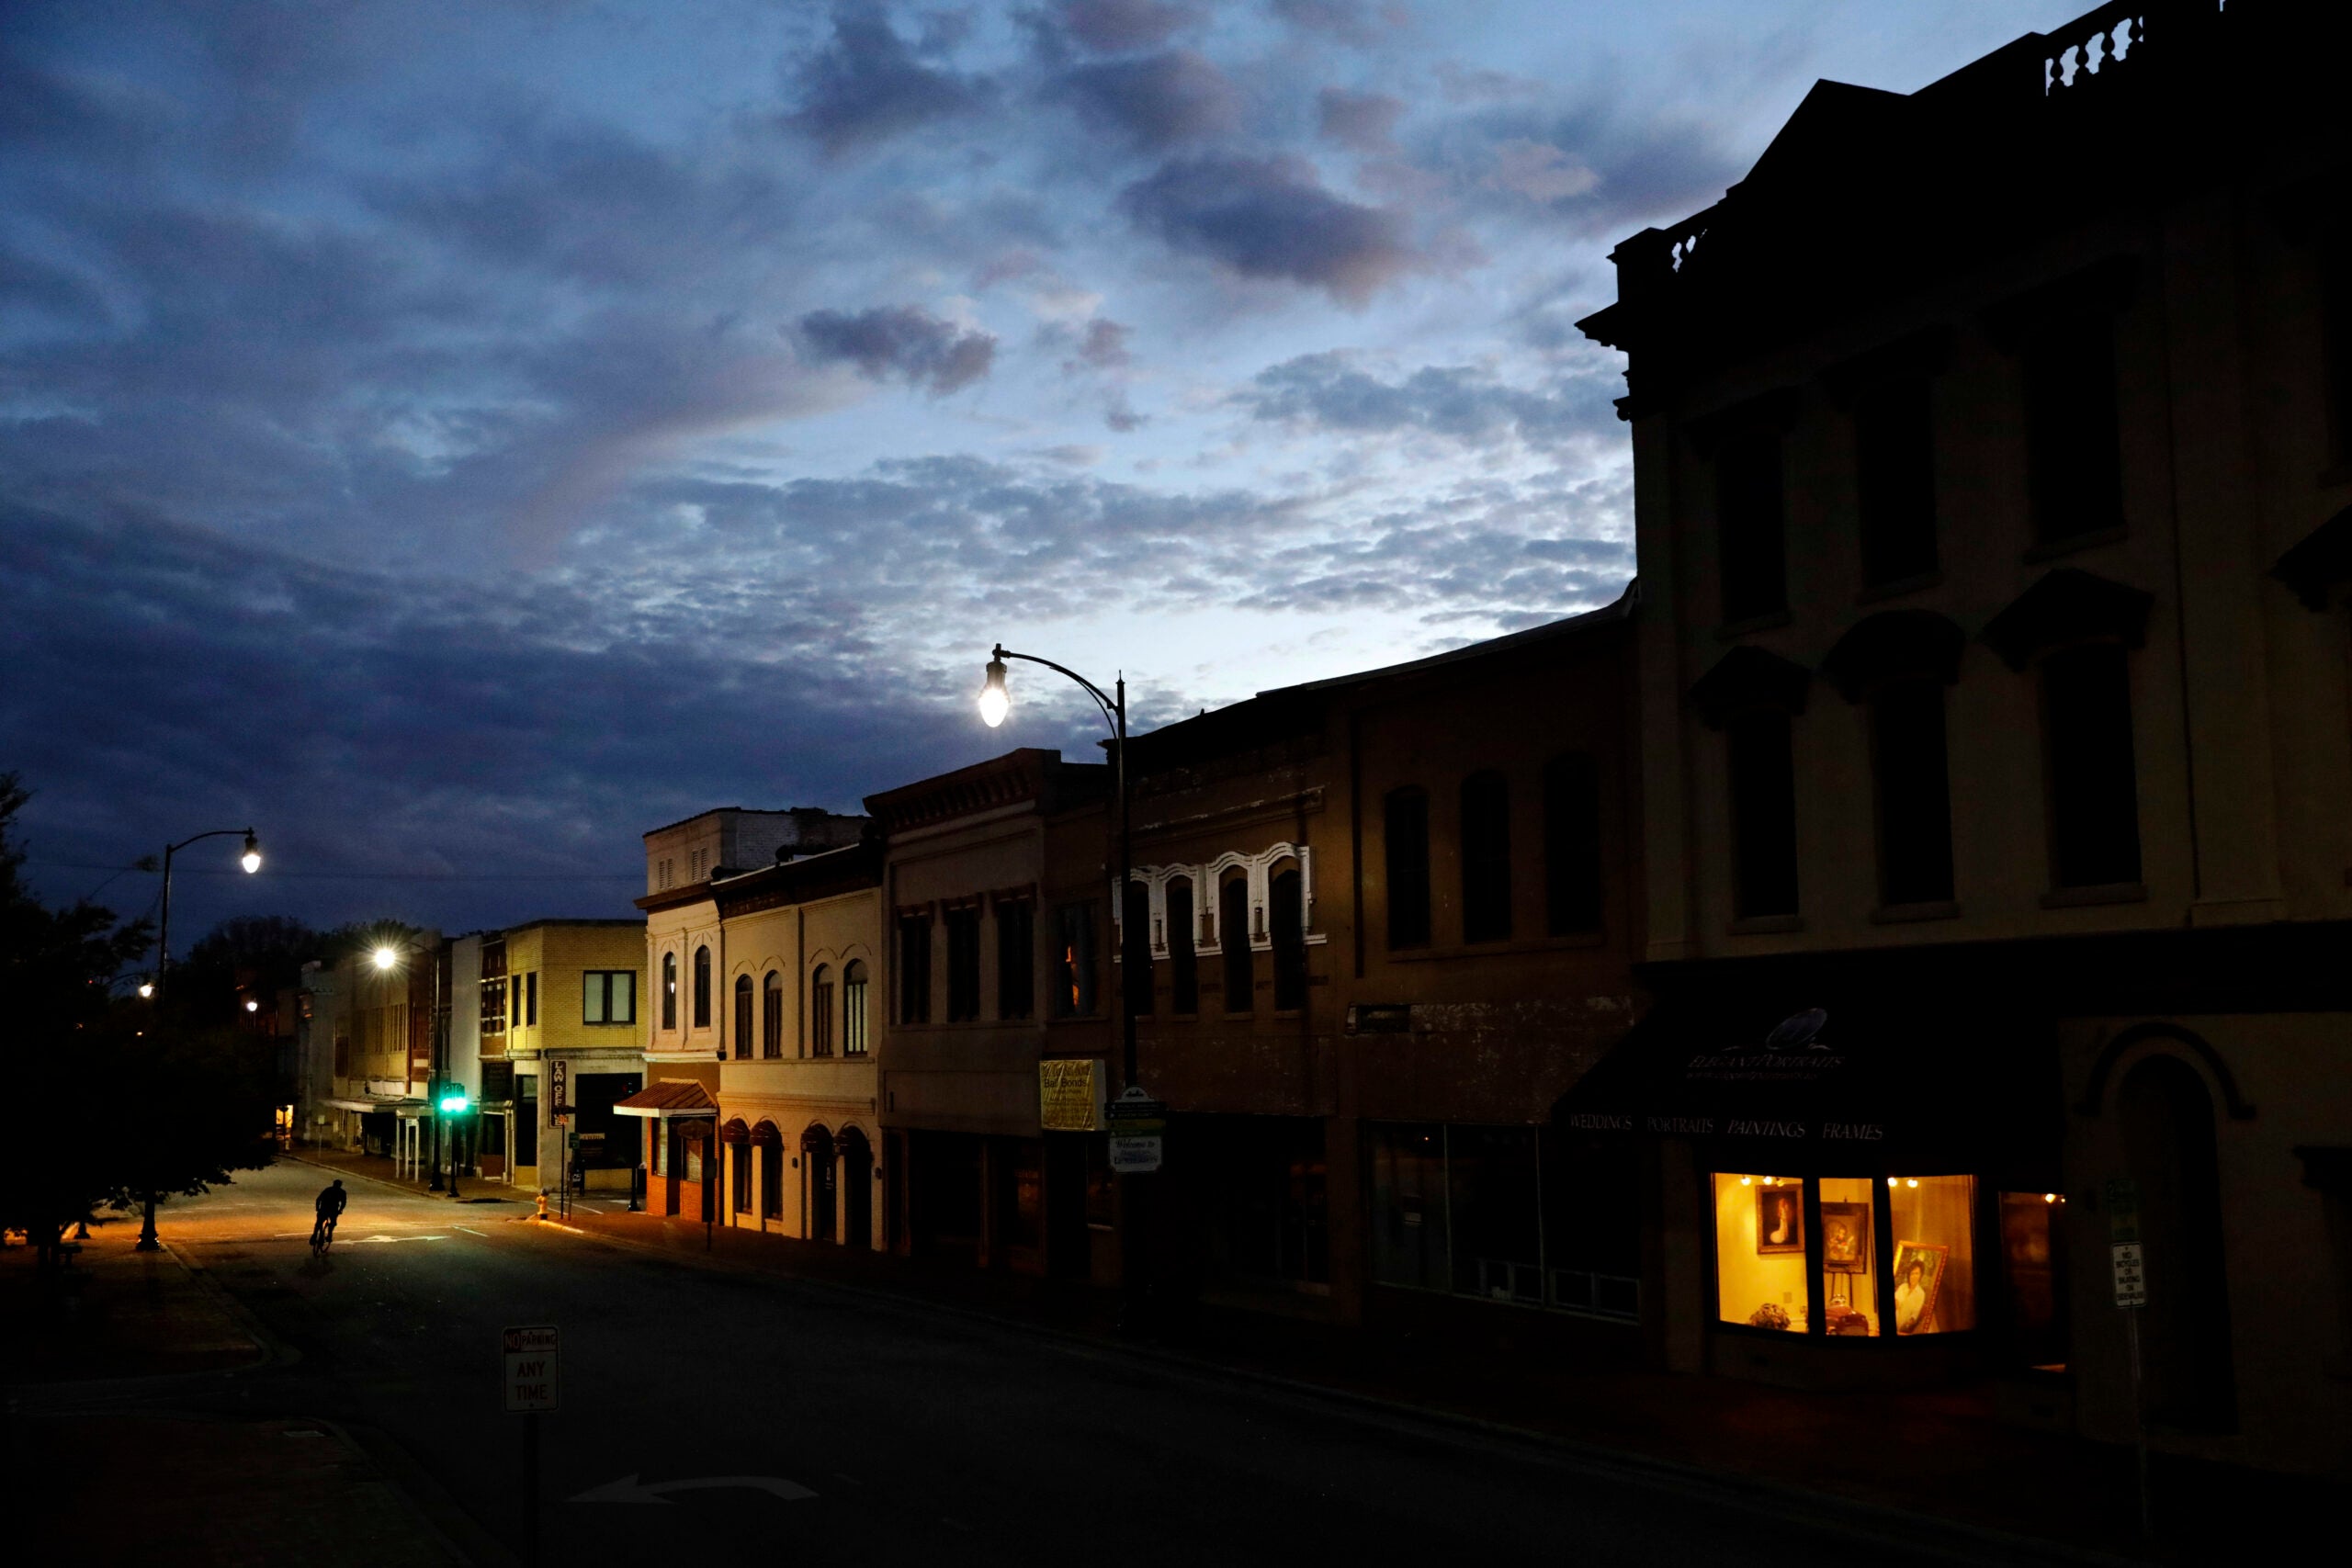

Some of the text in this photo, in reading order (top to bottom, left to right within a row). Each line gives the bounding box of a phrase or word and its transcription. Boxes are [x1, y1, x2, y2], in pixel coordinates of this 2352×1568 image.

[553, 1061, 565, 1083] LAW
[1044, 1077, 1087, 1089] Bai Bonds
[1570, 1113, 1883, 1141] WEDDINGS PORTRAITS PAINTINGS FRAMES
[504, 1333, 556, 1349] NO PARKING
[517, 1361, 545, 1377] ANY
[516, 1384, 548, 1401] TIME
